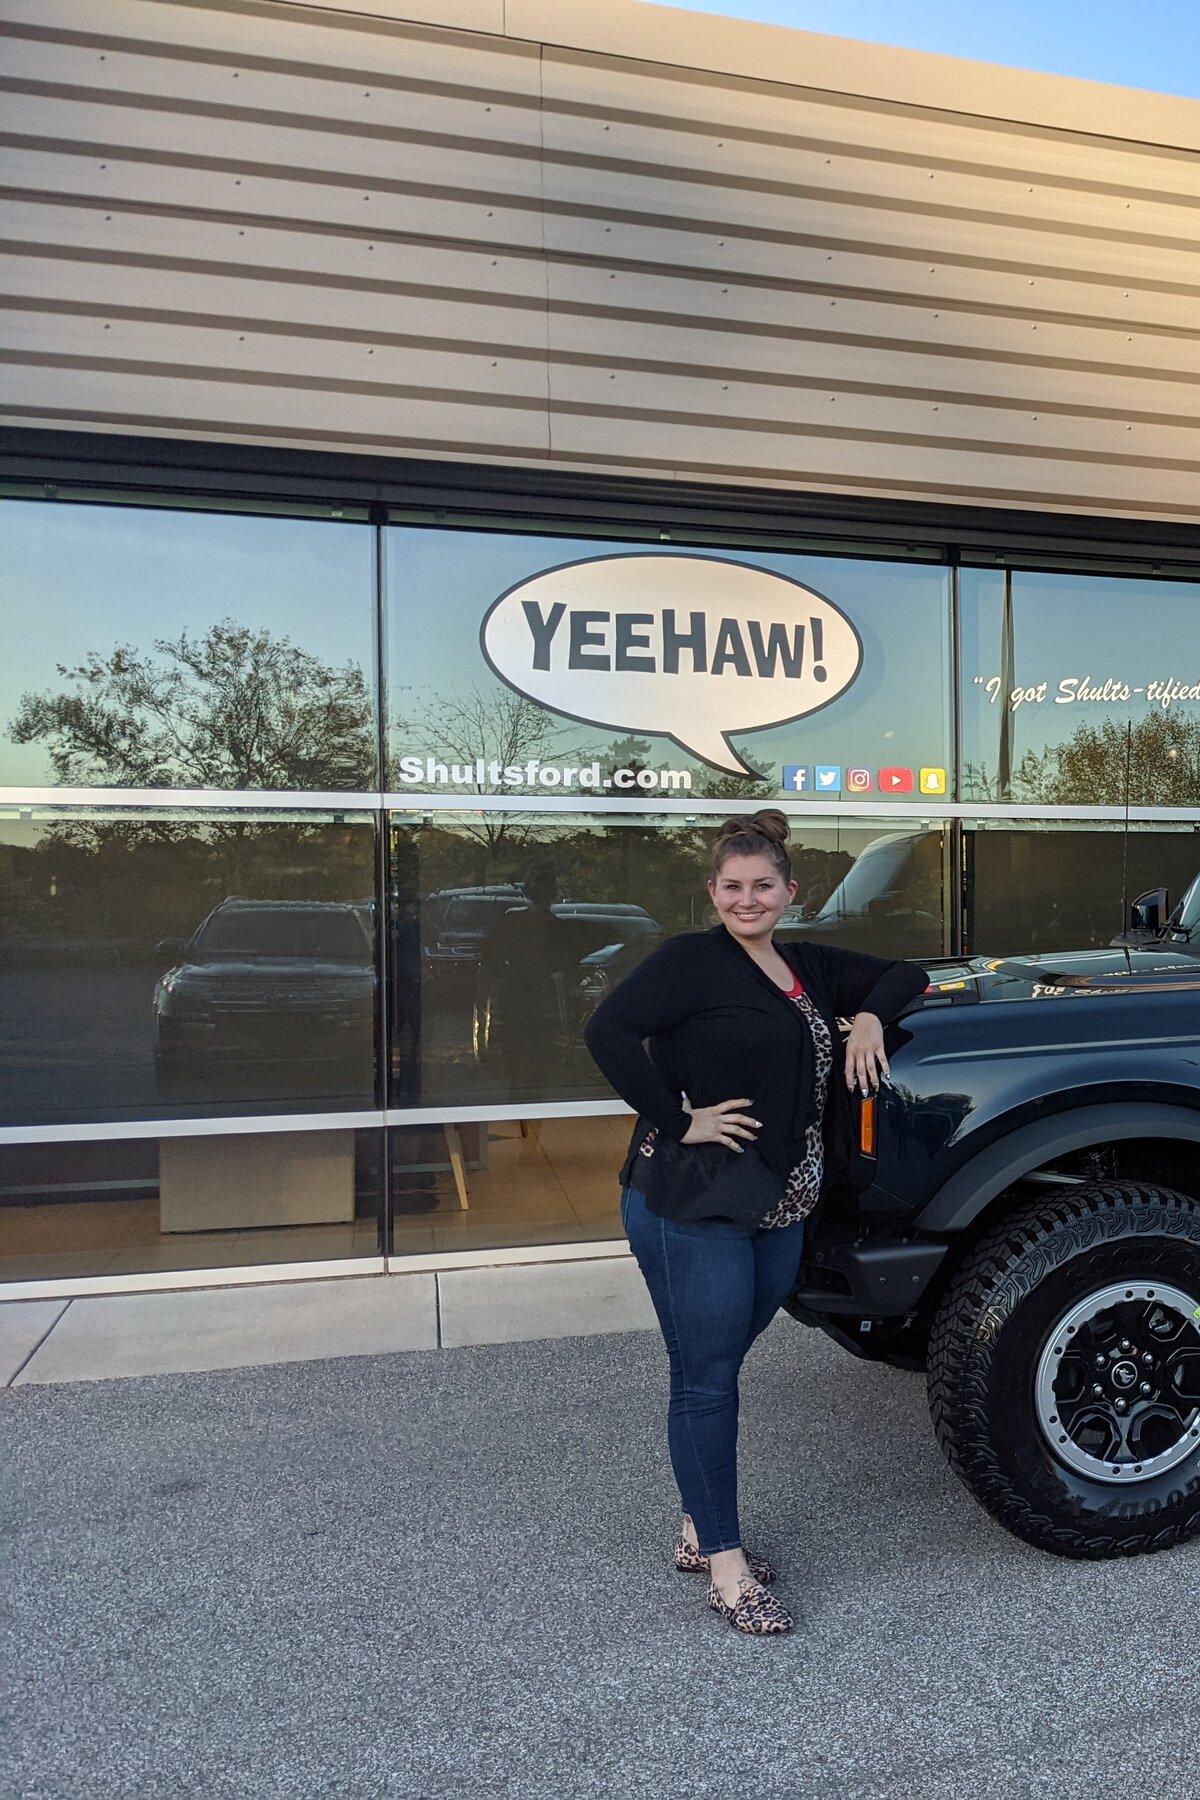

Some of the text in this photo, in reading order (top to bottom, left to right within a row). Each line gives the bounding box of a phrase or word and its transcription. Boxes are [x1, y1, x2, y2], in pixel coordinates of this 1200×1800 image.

[521, 600, 827, 683] YEEHAW!
[1009, 681, 1047, 711] got
[399, 756, 692, 790] Shultsford.com
